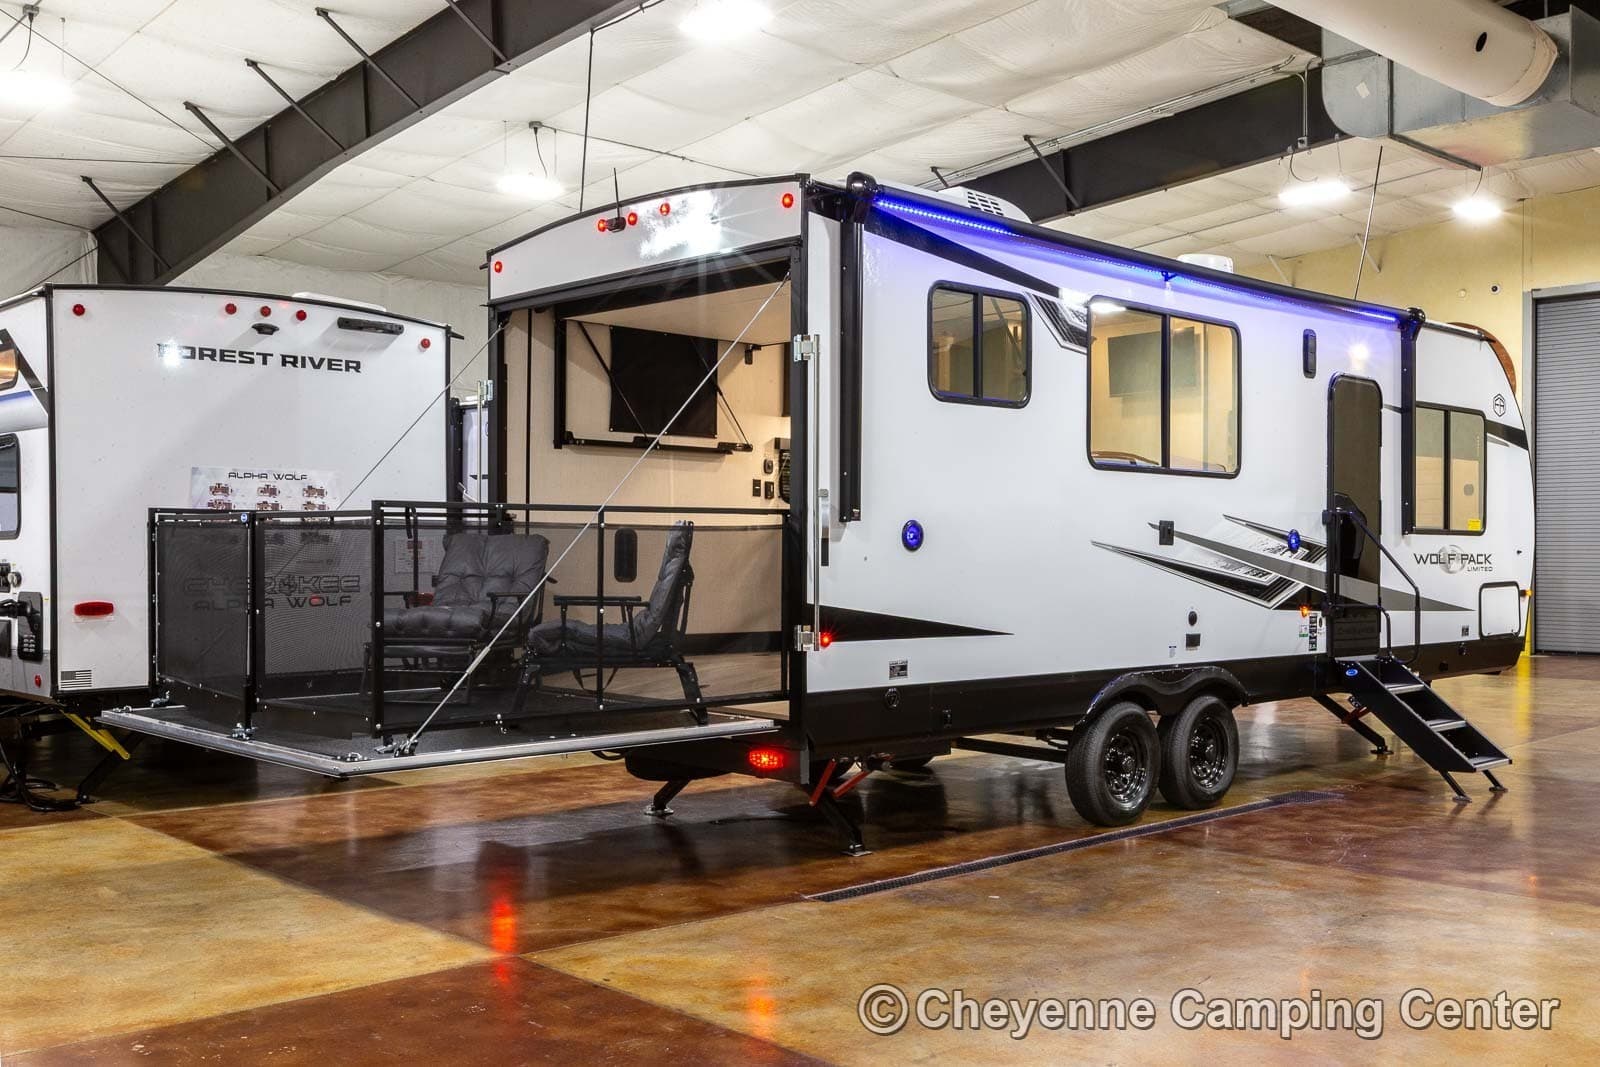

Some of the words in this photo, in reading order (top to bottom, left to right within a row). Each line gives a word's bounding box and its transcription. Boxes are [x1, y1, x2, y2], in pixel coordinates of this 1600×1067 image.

[279, 353, 362, 373] RIVER
[228, 472, 268, 480] ALPHA
[273, 473, 308, 481] WOLF
[1413, 553, 1457, 565] WOLF
[1460, 553, 1493, 565] PACK
[193, 598, 275, 611] ALPA
[287, 595, 353, 609] WOLF
